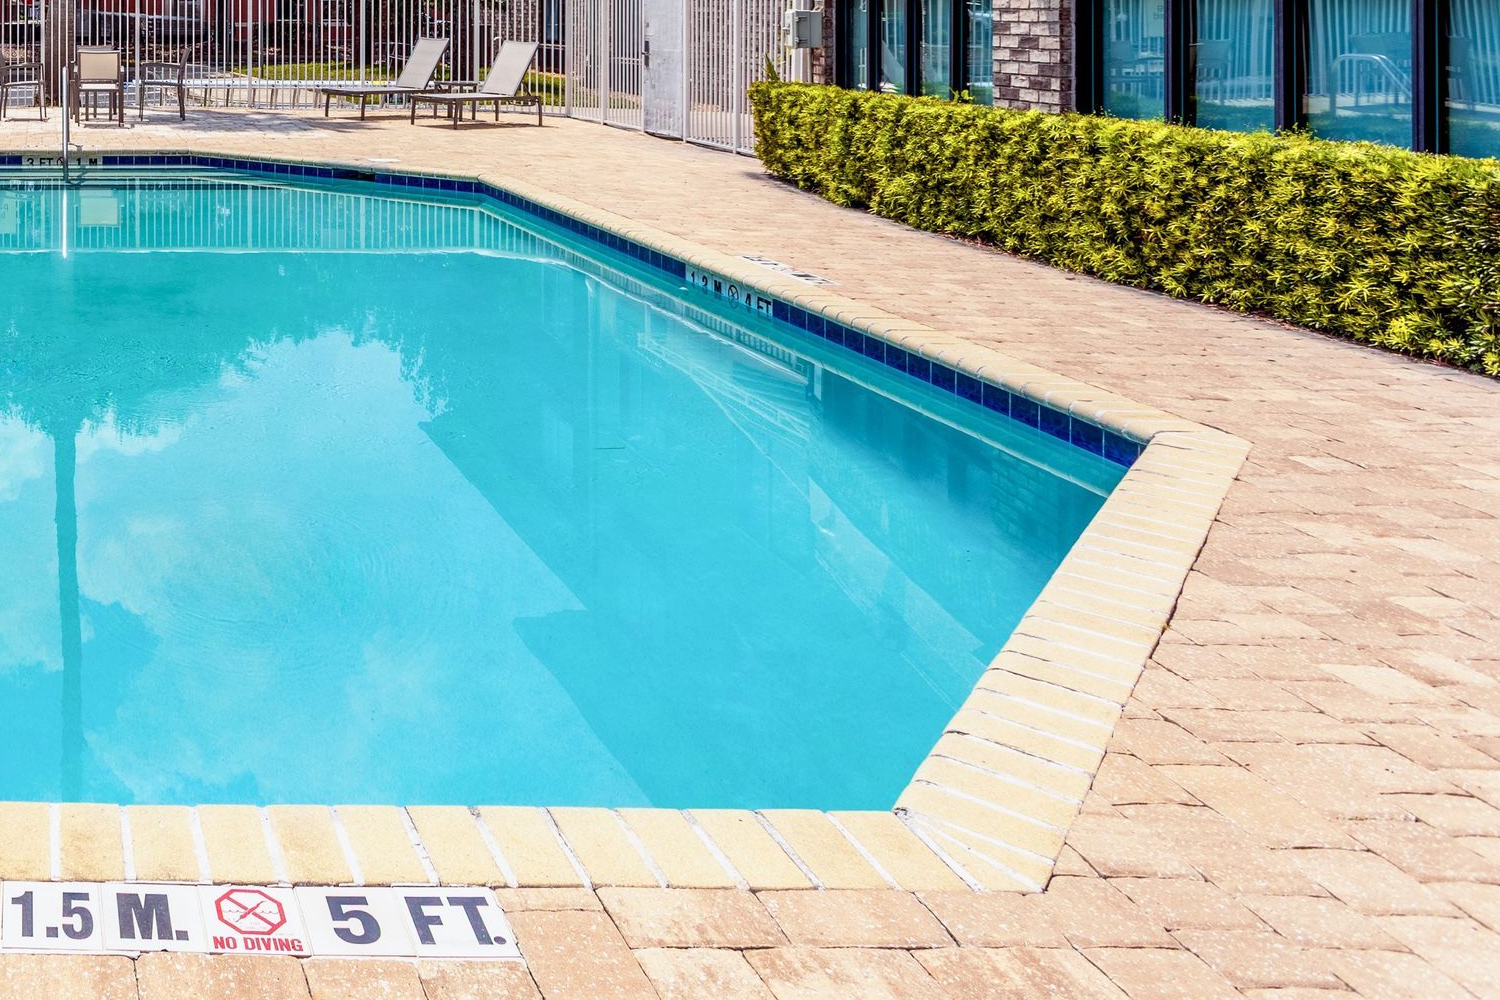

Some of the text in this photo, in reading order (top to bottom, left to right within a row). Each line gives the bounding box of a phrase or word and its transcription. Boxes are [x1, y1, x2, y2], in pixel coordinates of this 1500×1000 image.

[39, 157, 54, 166] FT
[88, 157, 98, 166] M
[713, 279, 722, 294] M
[757, 296, 772, 313] FT
[11, 890, 190, 941] 1.5 M.
[325, 895, 507, 945] 5 FT.
[212, 935, 304, 952] NO DIVING
